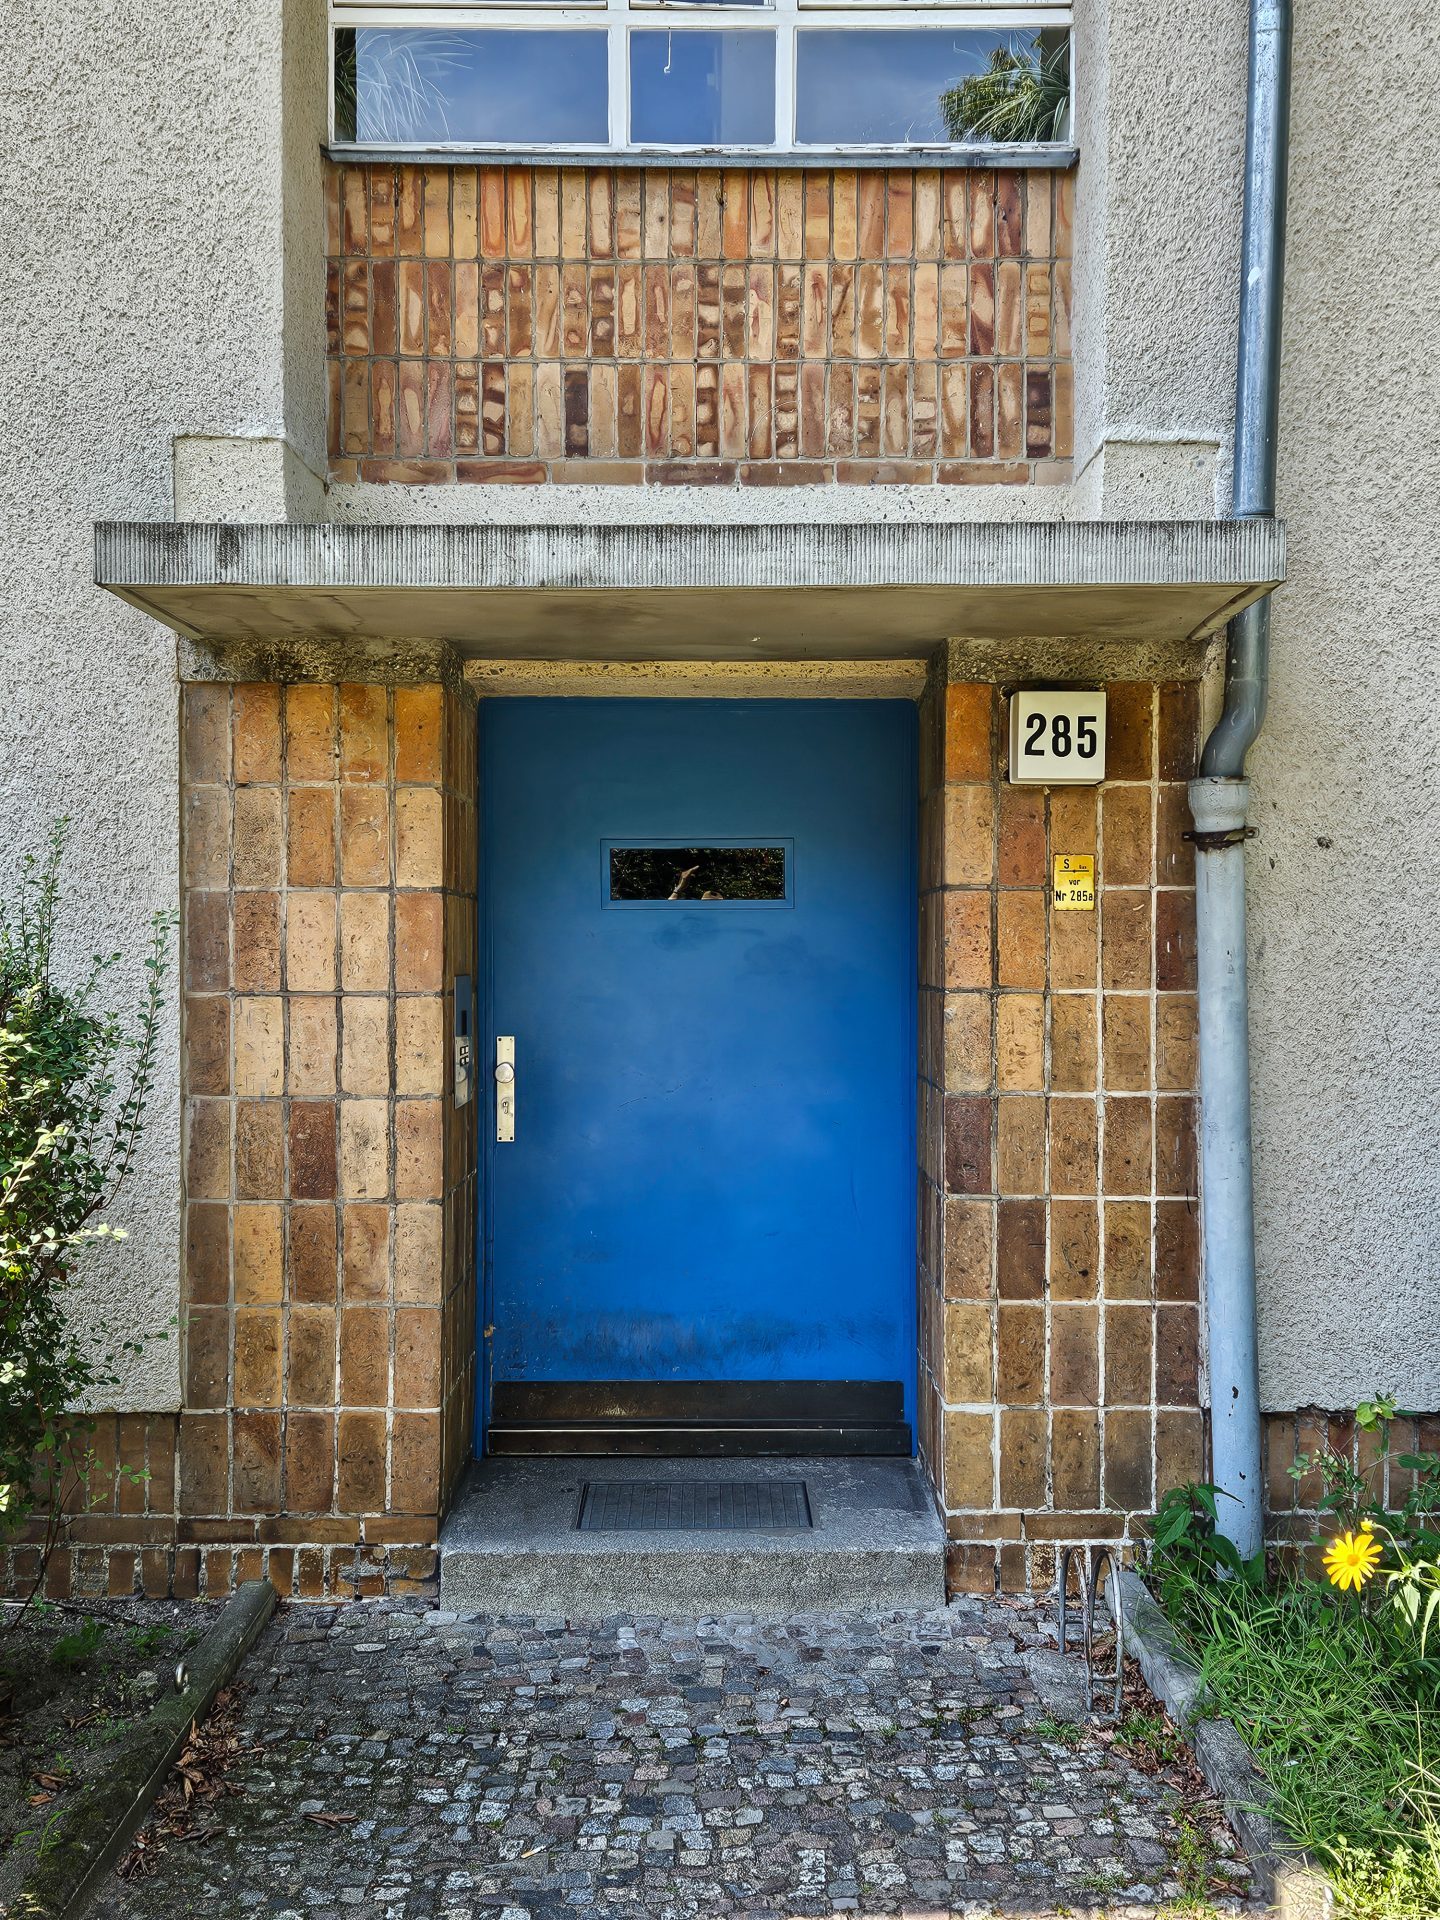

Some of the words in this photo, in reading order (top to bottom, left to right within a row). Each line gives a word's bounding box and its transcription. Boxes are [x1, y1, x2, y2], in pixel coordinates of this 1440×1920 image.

[1024, 712, 1097, 759] 285
[1063, 858, 1070, 869] S
[1055, 890, 1067, 901] Nr
[1070, 890, 1093, 901] 285a
